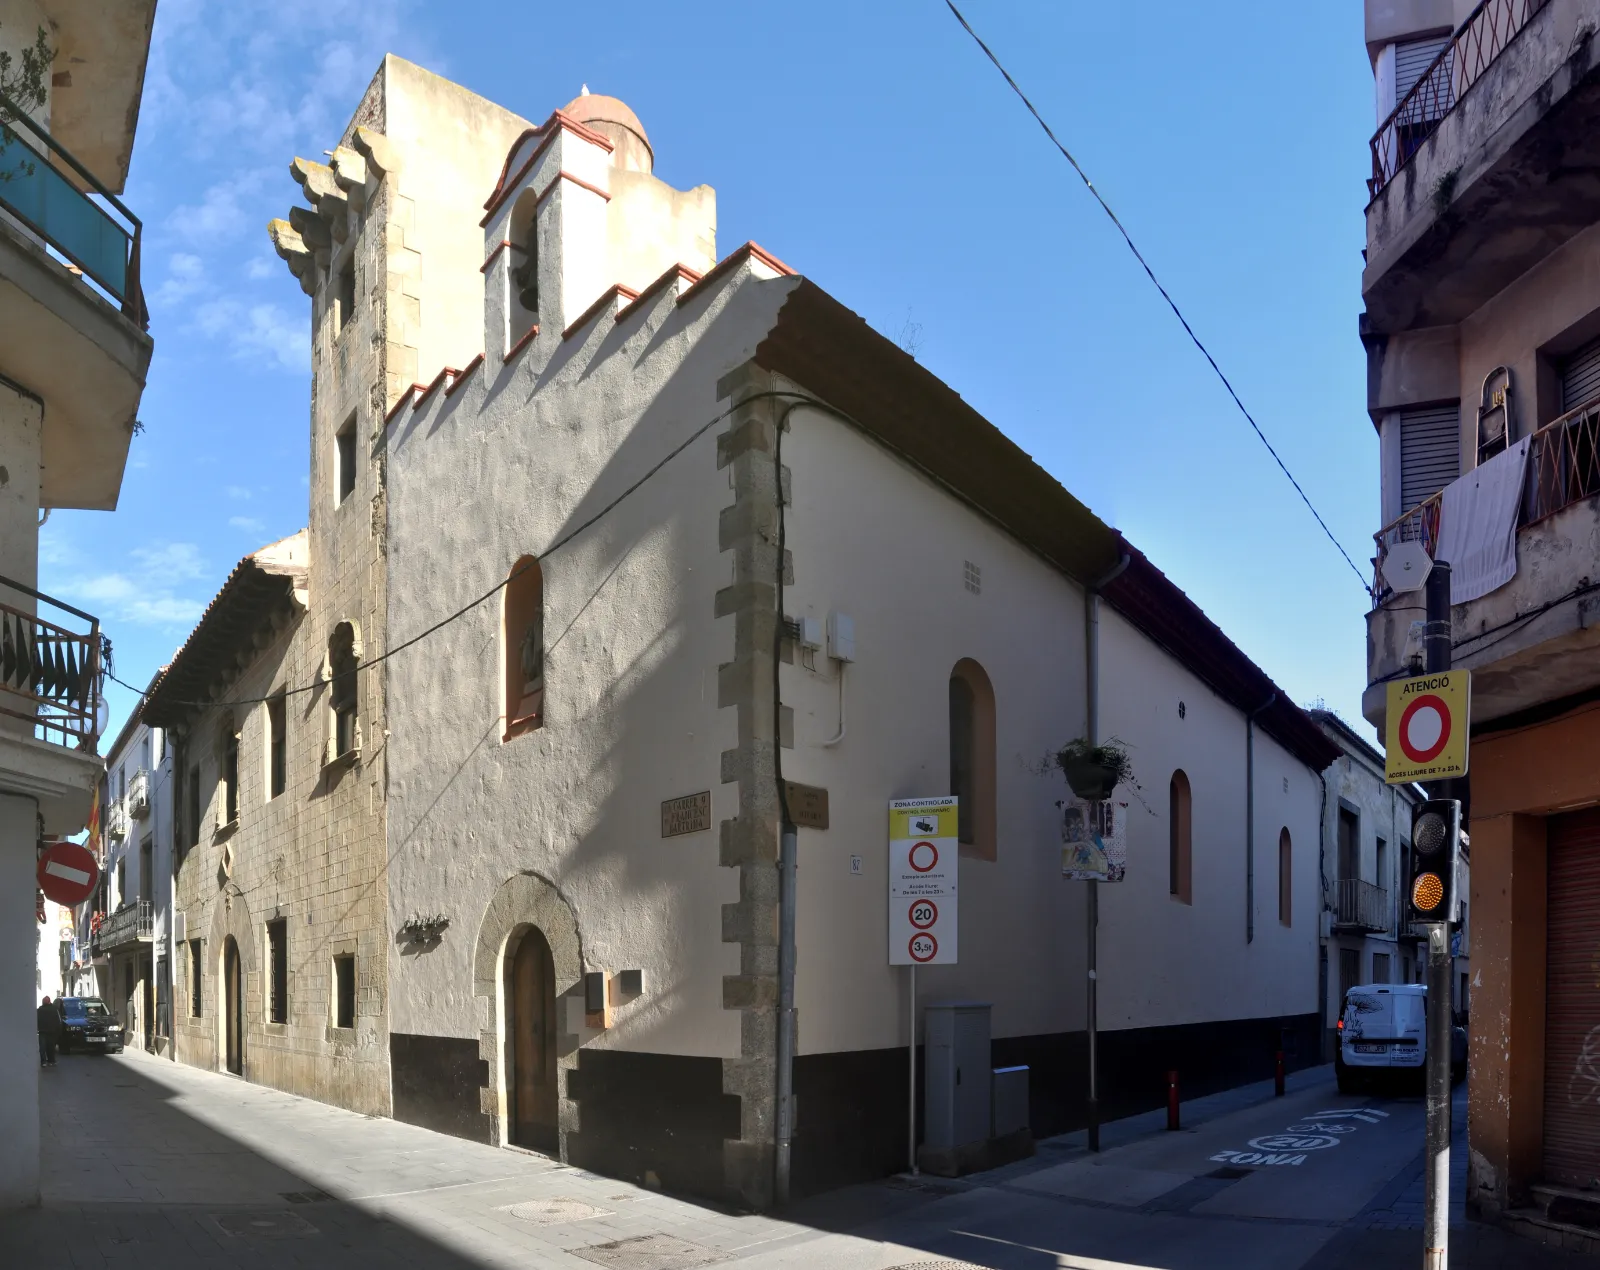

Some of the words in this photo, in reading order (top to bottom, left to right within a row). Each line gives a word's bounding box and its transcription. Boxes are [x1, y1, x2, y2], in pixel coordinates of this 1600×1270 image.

[1402, 674, 1450, 694] ATENCIÓ
[1407, 768, 1428, 776] LLIURE
[911, 799, 954, 807] CONTROLADA
[915, 908, 932, 920] 20
[914, 941, 932, 953] 3,5t
[1261, 1137, 1324, 1148] 20
[1209, 1150, 1308, 1166] ZONA
